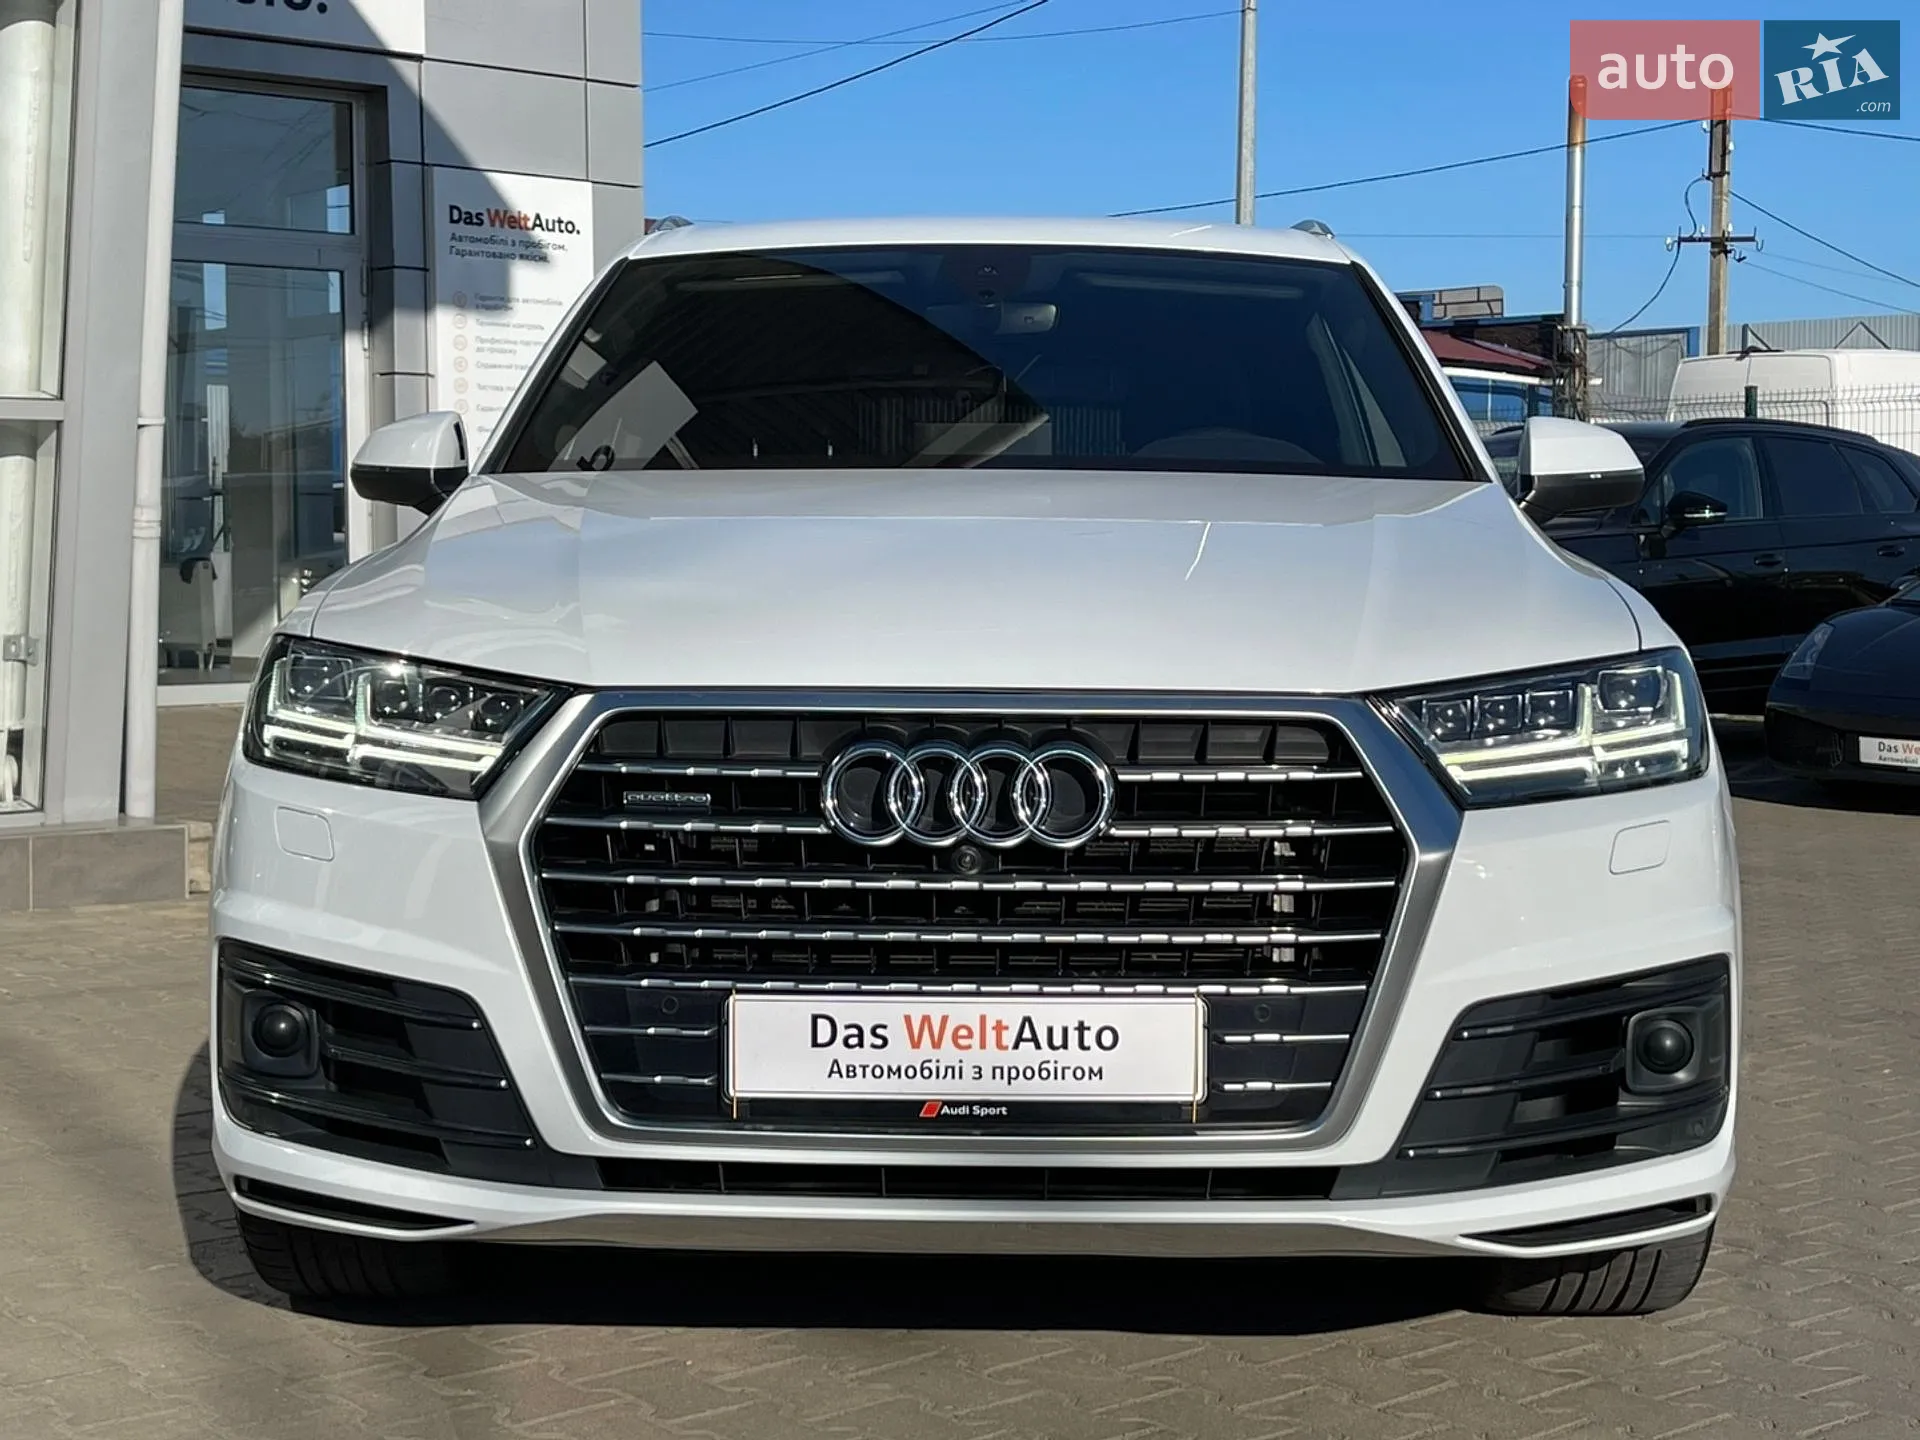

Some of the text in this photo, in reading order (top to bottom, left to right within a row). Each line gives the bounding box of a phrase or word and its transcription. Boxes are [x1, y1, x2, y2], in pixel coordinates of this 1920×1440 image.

[449, 204, 485, 226] Das
[450, 232, 509, 245] Автомобілі
[449, 245, 517, 260] Гарантовано
[1878, 741, 1898, 753] Das
[627, 793, 707, 803] quattro
[811, 1013, 1119, 1051] Das WeltAuto
[827, 1058, 1103, 1086] Автомобілі з пробігом
[940, 1105, 1008, 1117] Audi Sport
